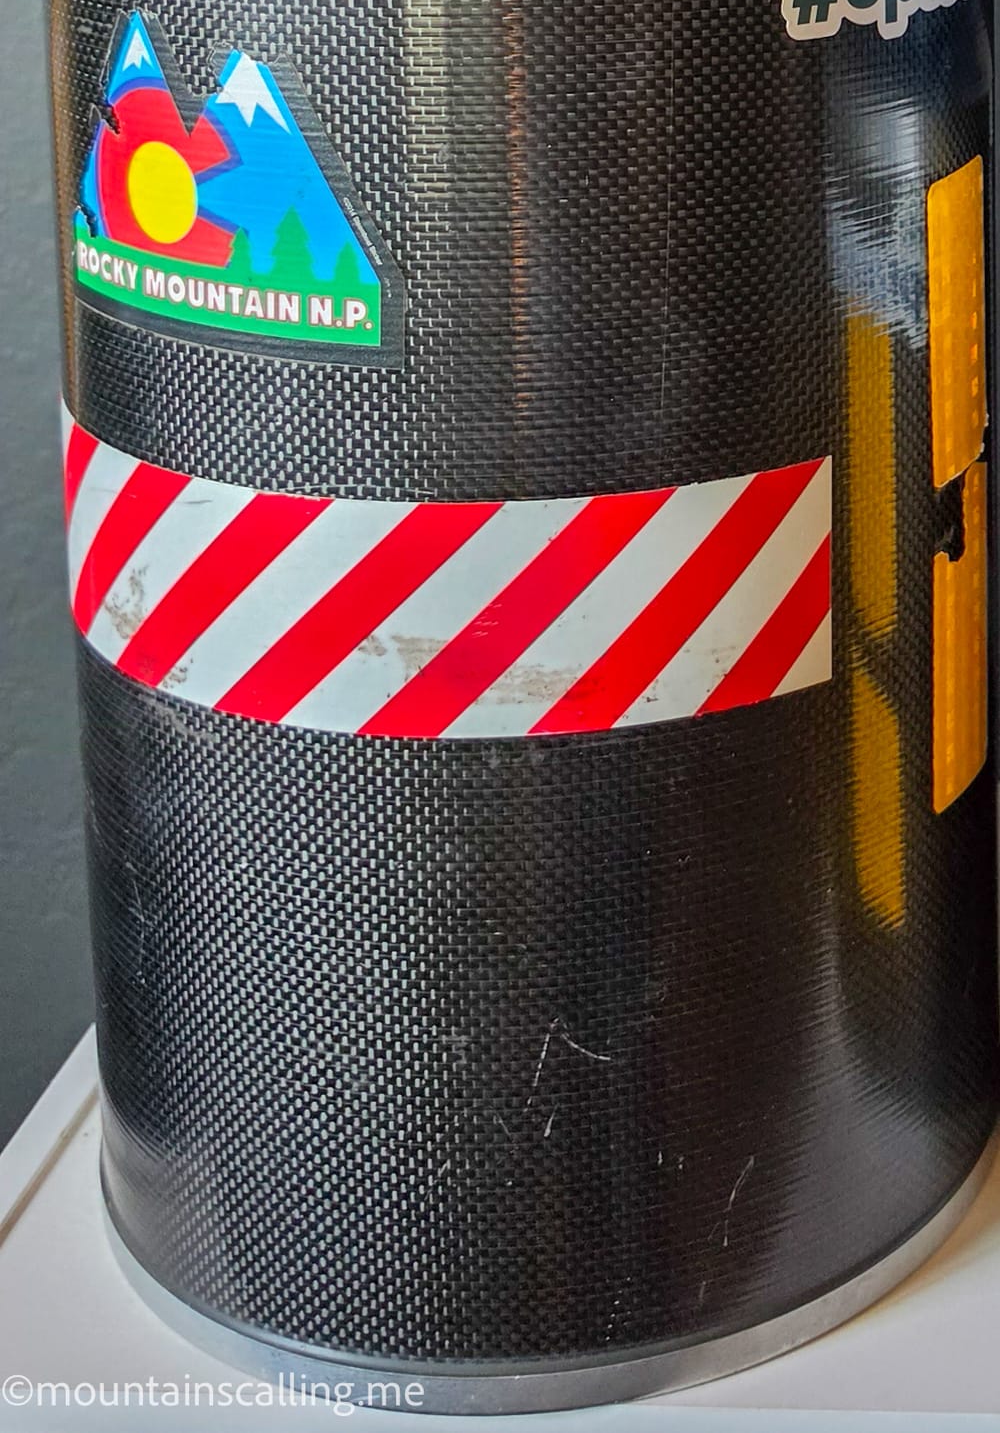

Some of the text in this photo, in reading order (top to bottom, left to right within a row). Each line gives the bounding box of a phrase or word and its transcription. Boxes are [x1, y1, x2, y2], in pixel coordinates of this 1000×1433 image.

[76, 241, 374, 331] ROCKY MOUNTAIN N.P.
